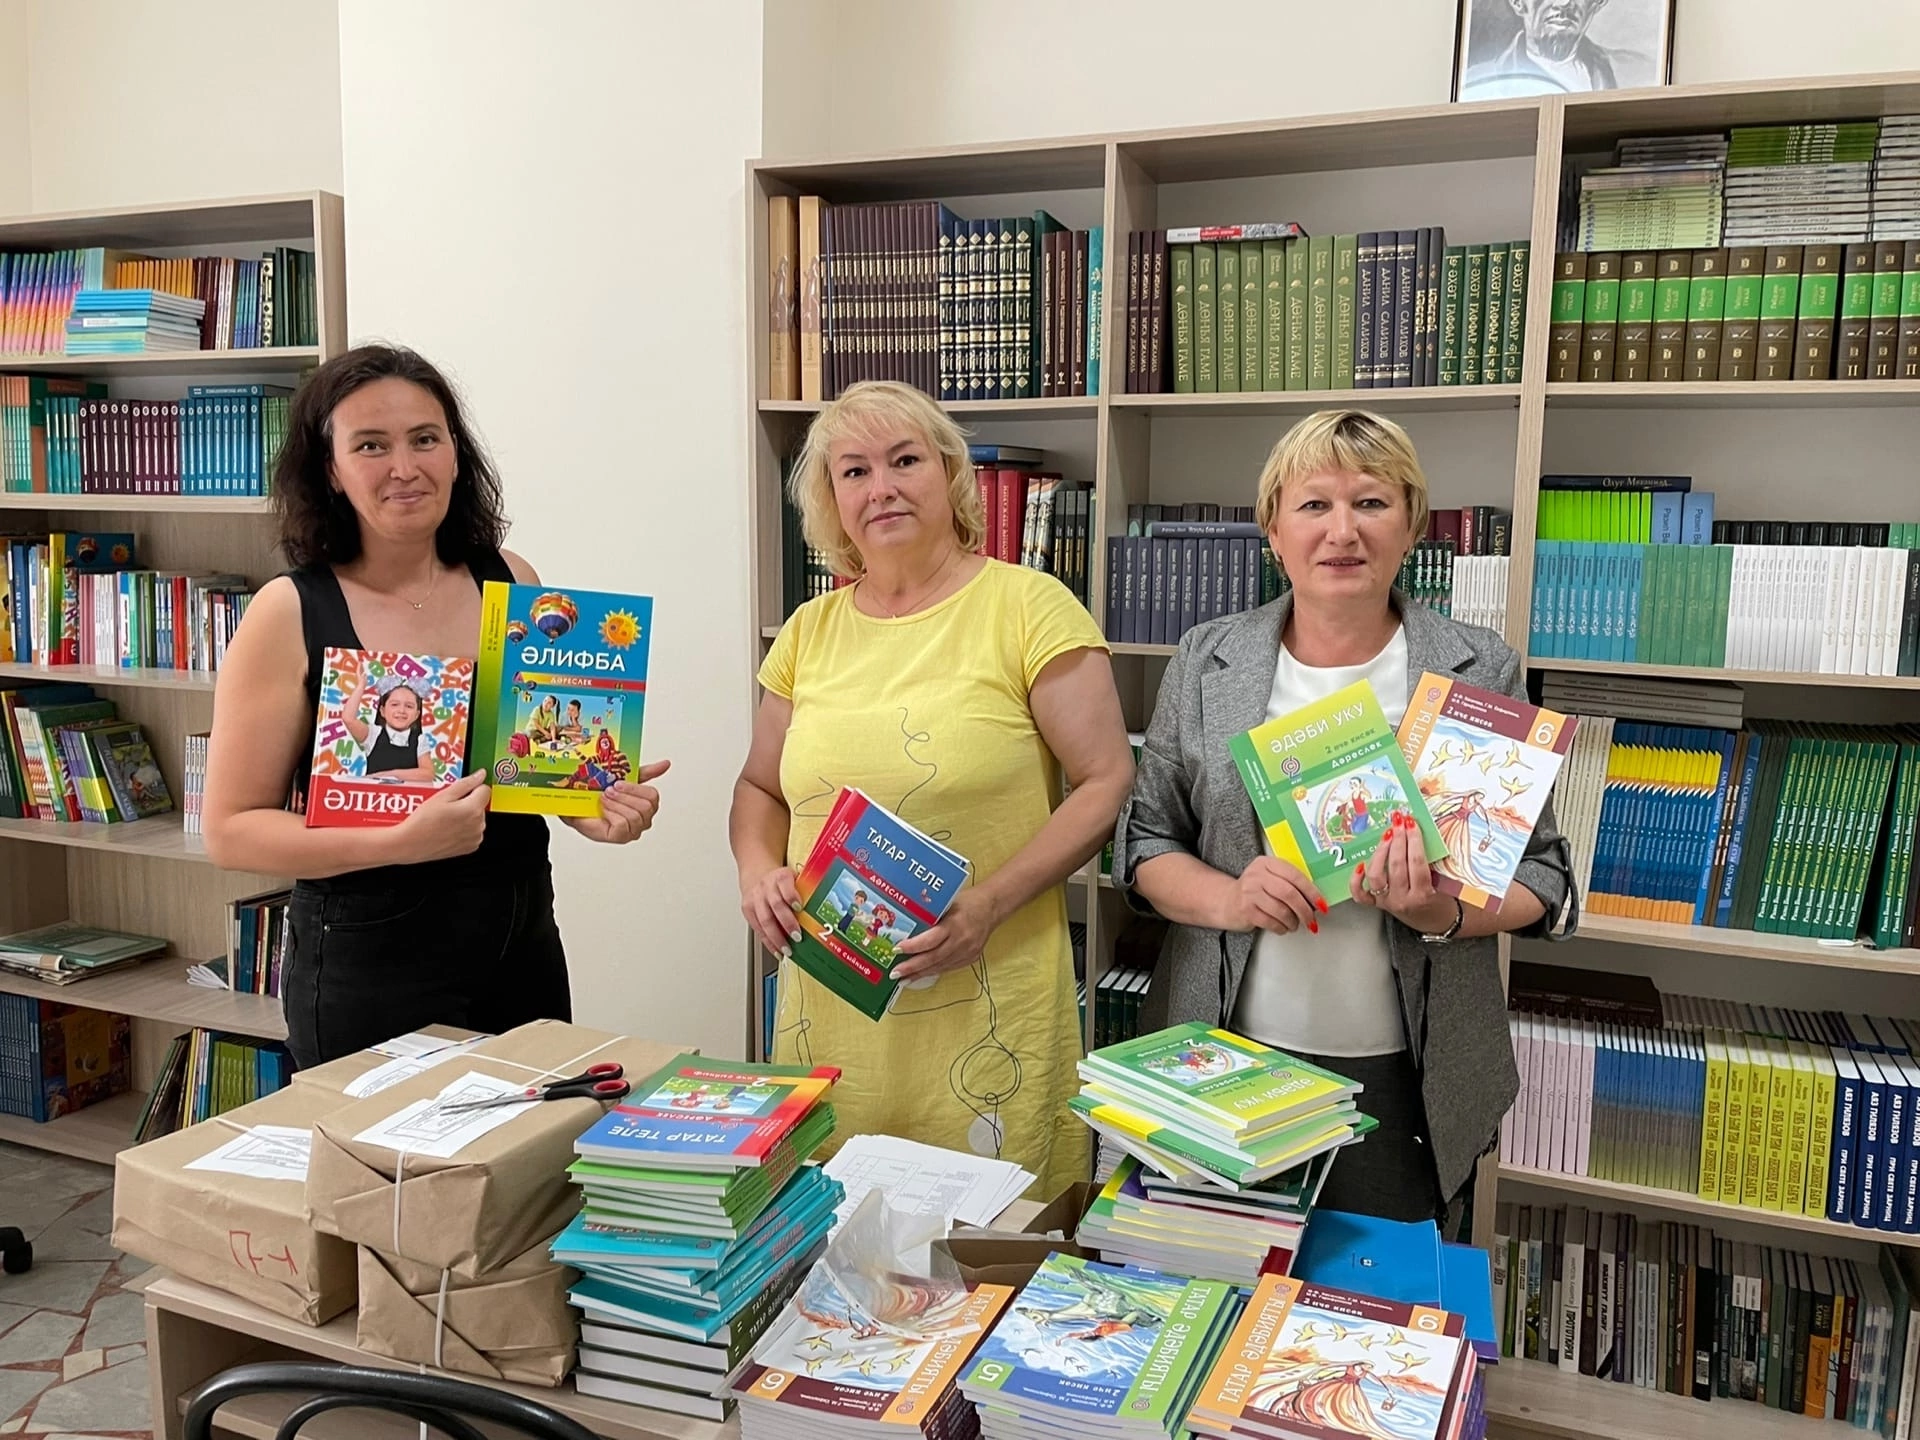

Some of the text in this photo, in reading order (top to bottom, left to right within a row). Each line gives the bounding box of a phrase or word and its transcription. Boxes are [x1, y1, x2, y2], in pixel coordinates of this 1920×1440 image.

[1360, 268, 1371, 359] ДАНИЛ САЛИХОВ
[1379, 267, 1391, 358] ДАНИЛ САЛИХОВ
[1399, 266, 1411, 358] ДАНИЛ САЛИХОВ
[521, 646, 625, 672] ӘЛИФБА
[1446, 706, 1453, 715] 2
[1454, 711, 1468, 720] нче
[1270, 702, 1364, 753] ӘДӘБИ УКУ
[1535, 722, 1555, 745] 6
[1331, 741, 1382, 769] Дәреслек
[324, 789, 424, 814] ӘЛИФБ
[866, 827, 906, 862] ТАТАР
[906, 858, 945, 892] ТЕЛЕ
[1330, 845, 1367, 868] 2 нче
[818, 923, 834, 942] 2
[842, 952, 871, 975] сыйныф
[1182, 1038, 1203, 1048] 2
[751, 1077, 771, 1087] 2
[1233, 1078, 1315, 1111] ӘДӘБИ УКУ
[608, 1125, 727, 1143] ТАТАР ТЕЛЕ
[1312, 1301, 1331, 1309] нче
[1333, 1305, 1363, 1316] кисәк
[749, 1312, 766, 1338] ТАТАР
[1417, 1314, 1440, 1331] 6
[1139, 1286, 1211, 1392] ТАТАР ӘДӘБИЯТЫ
[1217, 1297, 1287, 1403] ТАТАР ӘДӘБИЯТЫ
[907, 1334, 962, 1395] ДӘБИЯТЫ
[977, 1363, 1004, 1382] 5
[761, 1372, 785, 1391] 6
[832, 1386, 862, 1397] кисәк
[1058, 1379, 1120, 1397] 2 нче кисәк
[863, 1390, 881, 1399] нче
